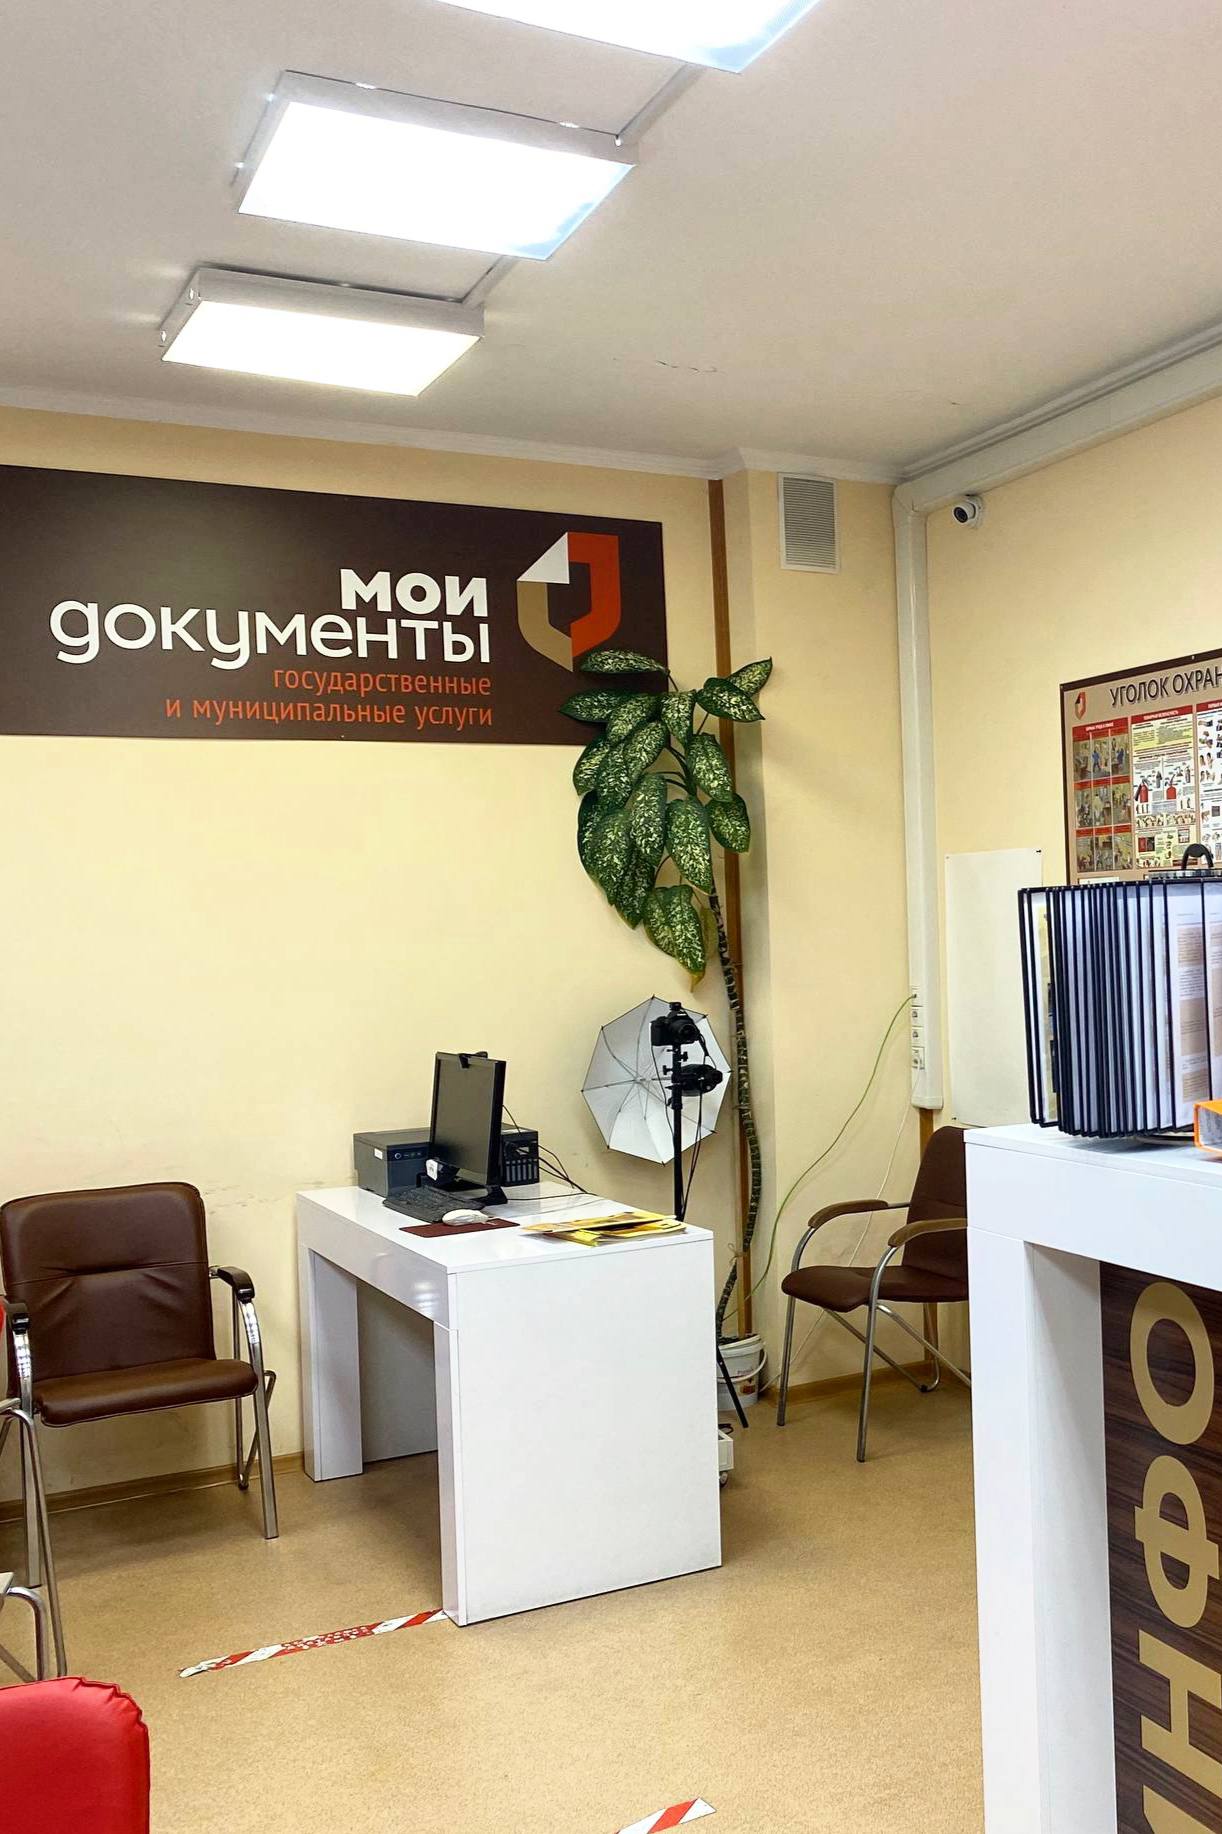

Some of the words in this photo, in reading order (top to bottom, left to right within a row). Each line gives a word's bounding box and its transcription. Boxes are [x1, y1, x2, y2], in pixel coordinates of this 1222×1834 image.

[340, 568, 488, 617] мои
[49, 600, 490, 670] документы
[273, 669, 492, 698] государственные
[1109, 676, 1170, 707] УГОЛОК
[165, 698, 182, 719] и
[191, 699, 406, 726] муниципальные
[414, 706, 492, 731] услуги
